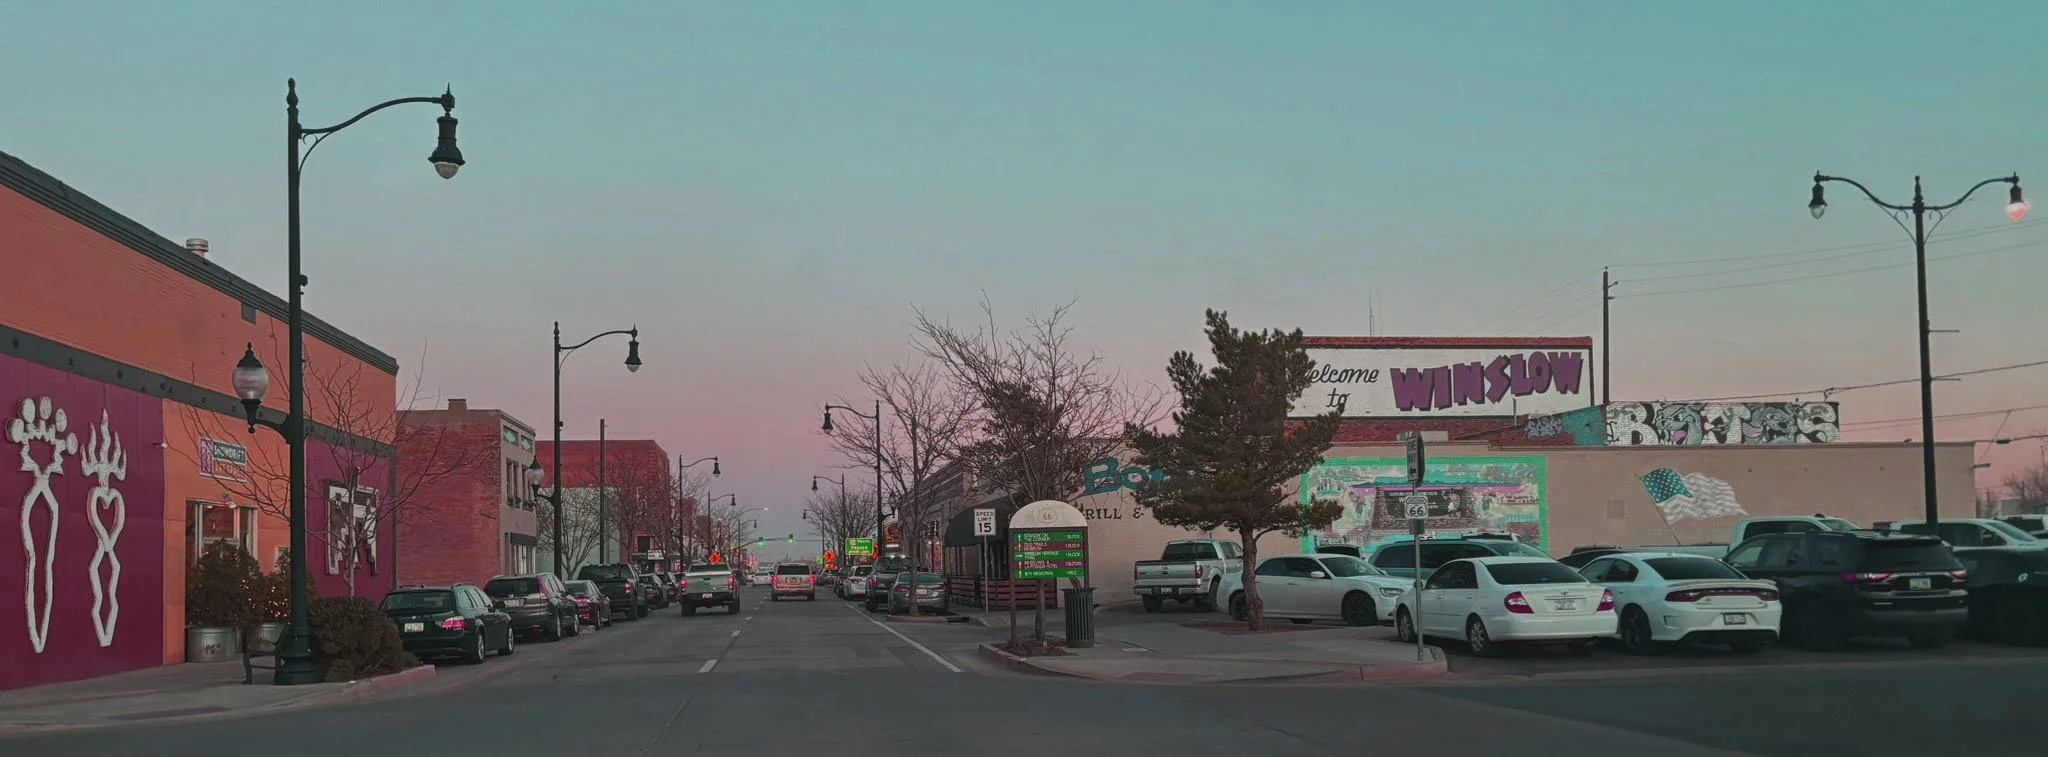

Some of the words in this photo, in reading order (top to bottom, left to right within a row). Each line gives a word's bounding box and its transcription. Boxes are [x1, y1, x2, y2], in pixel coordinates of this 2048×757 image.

[1390, 351, 1583, 411] WINSLOW
[1326, 387, 1351, 408] to
[1043, 512, 1053, 521] 66
[1079, 505, 1122, 520] RILL
[1132, 506, 1144, 519] &
[1409, 506, 1424, 515] 66
[978, 522, 992, 533] 15
